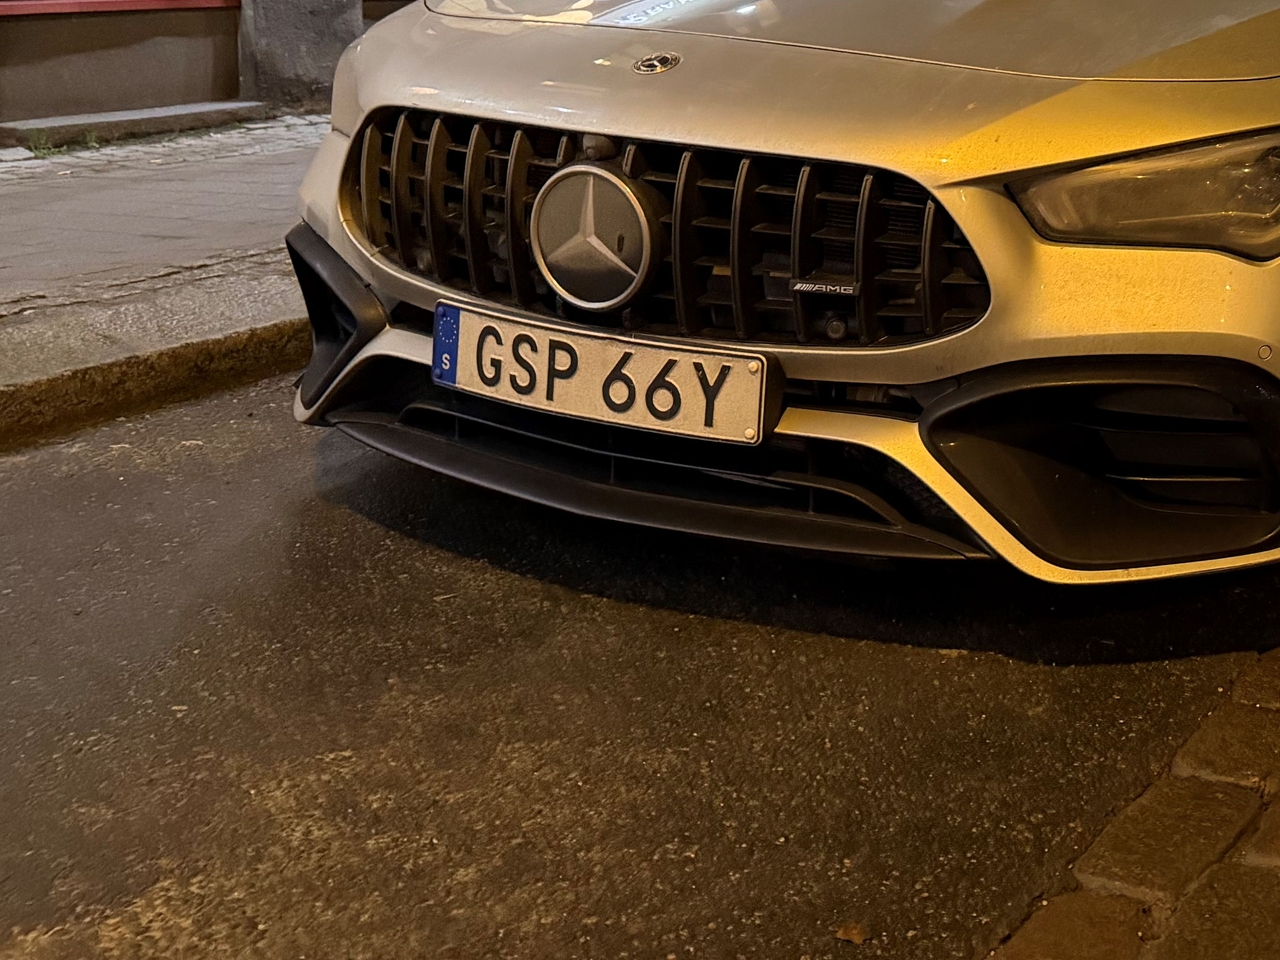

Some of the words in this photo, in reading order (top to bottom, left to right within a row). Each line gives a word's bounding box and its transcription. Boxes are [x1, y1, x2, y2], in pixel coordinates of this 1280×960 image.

[812, 283, 854, 294] AMG
[441, 353, 451, 371] S
[476, 324, 579, 402] GSP
[602, 350, 732, 428] 66Y
